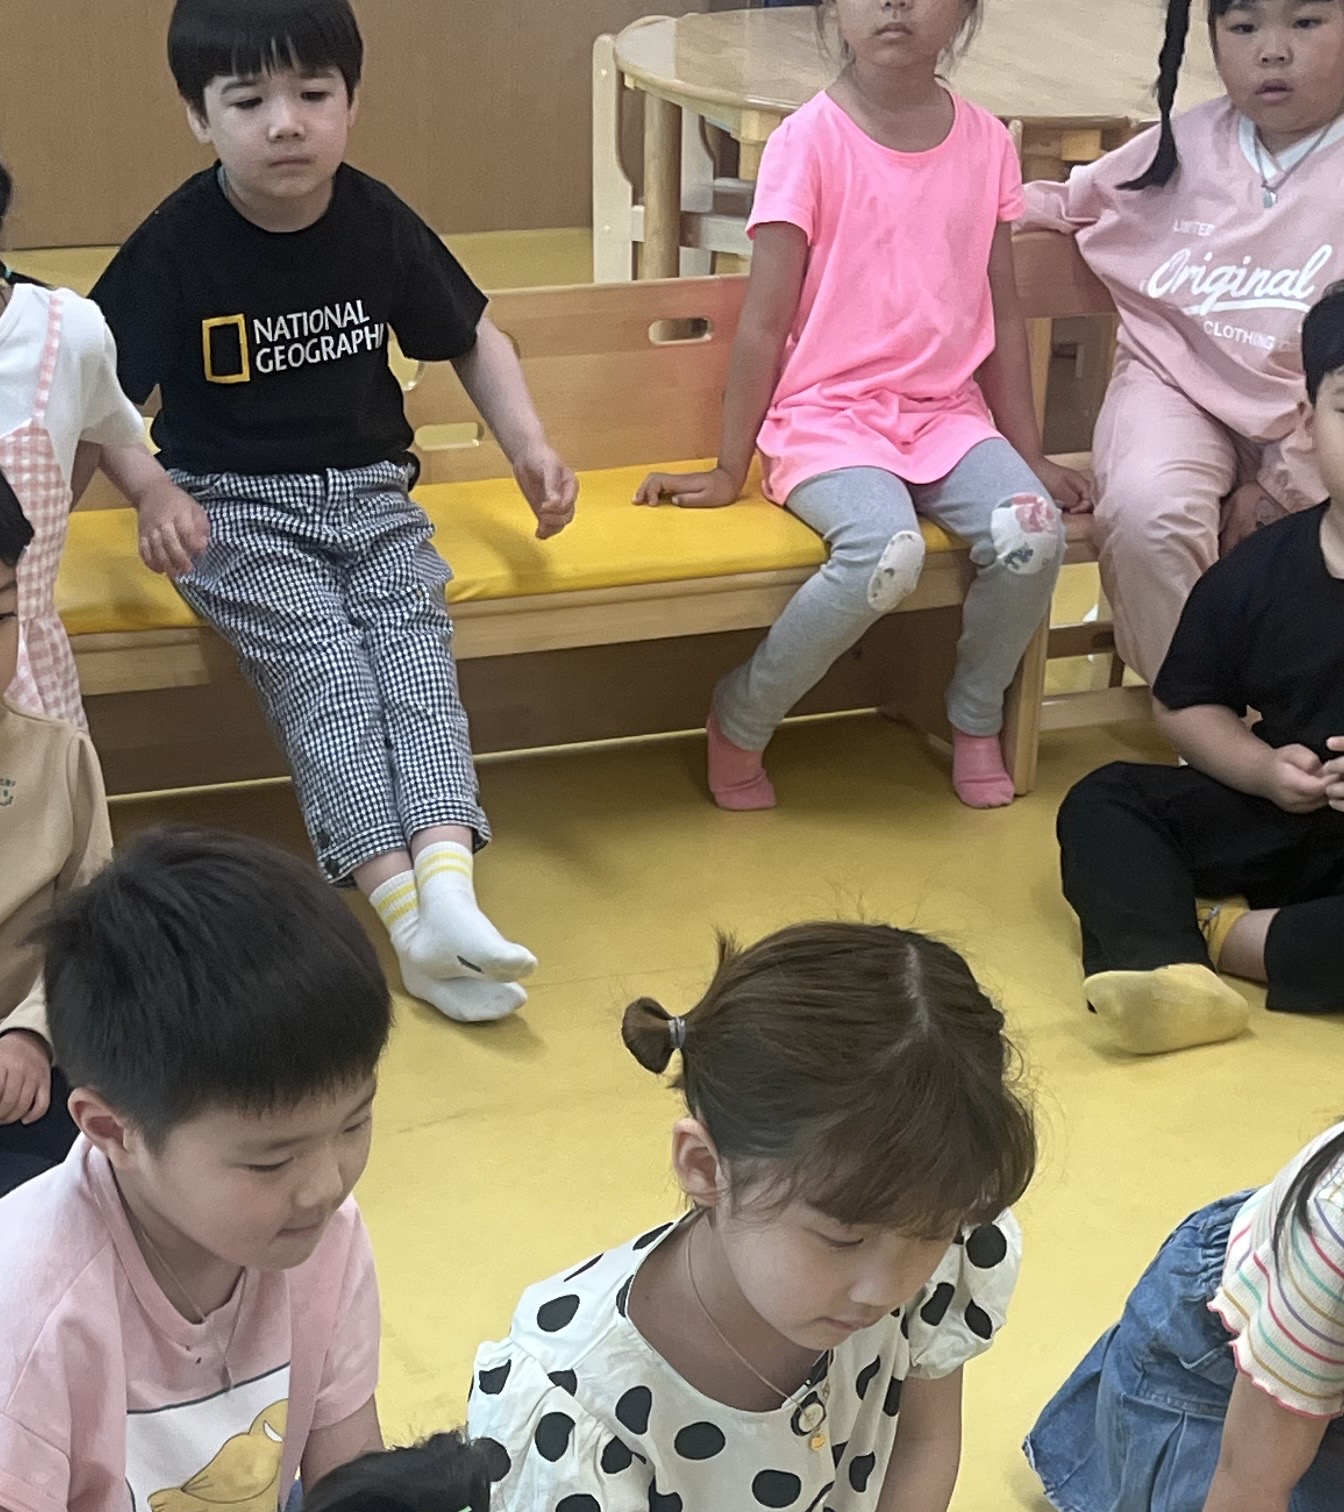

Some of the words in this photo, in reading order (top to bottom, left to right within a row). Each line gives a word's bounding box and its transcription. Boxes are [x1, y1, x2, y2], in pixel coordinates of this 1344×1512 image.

[1147, 244, 1333, 316] Original
[253, 299, 370, 345] NATIONAL
[256, 323, 385, 374] GEOGRAPHI
